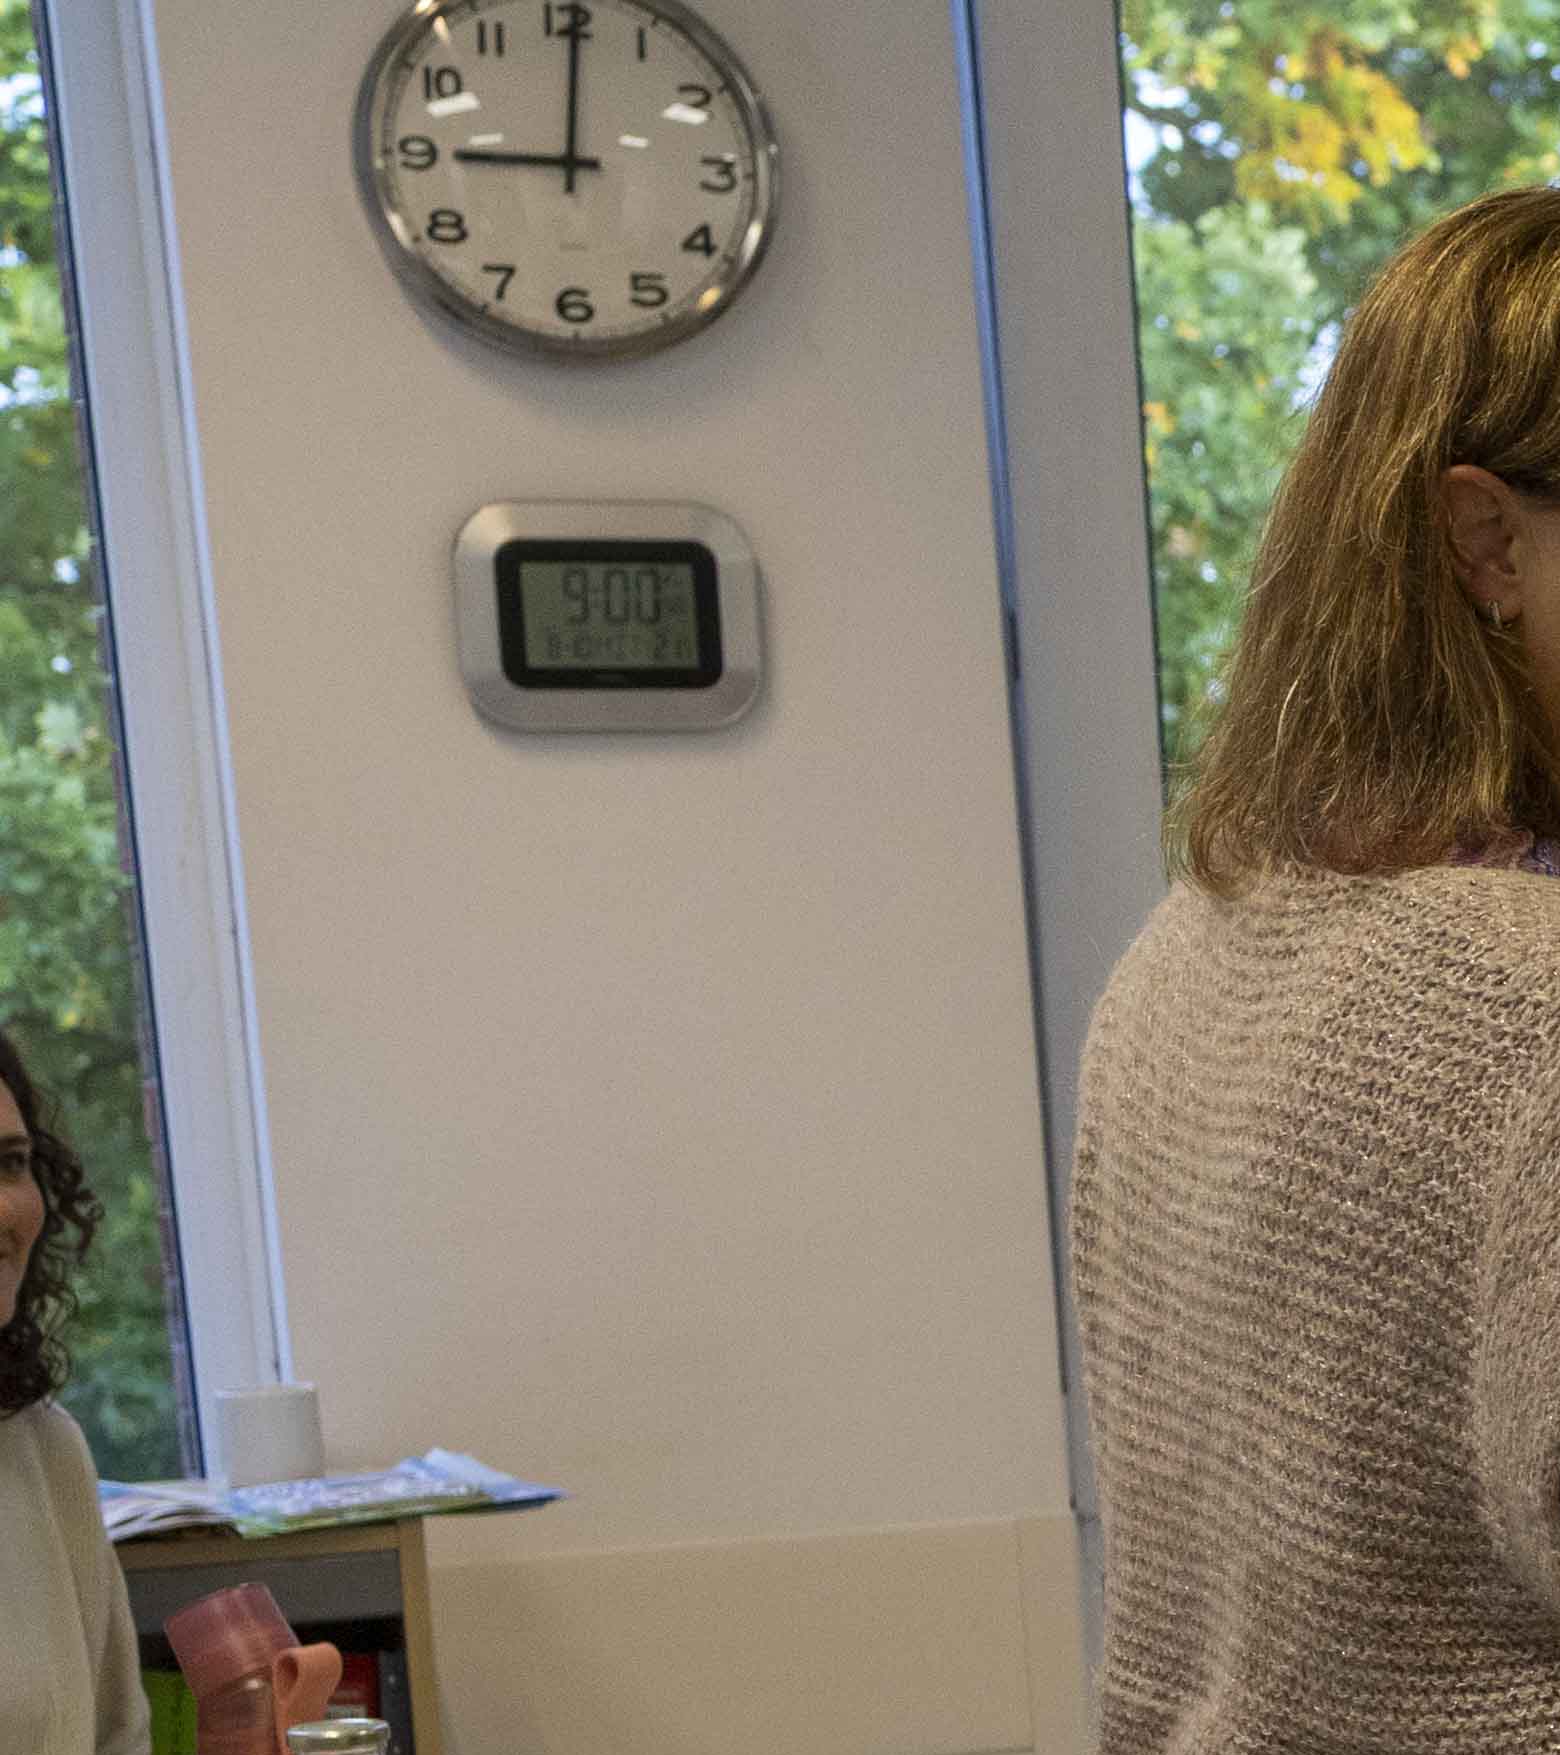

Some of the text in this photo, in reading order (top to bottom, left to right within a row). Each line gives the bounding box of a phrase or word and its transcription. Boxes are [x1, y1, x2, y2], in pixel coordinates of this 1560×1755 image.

[544, 2, 592, 38] 12
[476, 21, 504, 57] 11
[635, 26, 646, 62] 1
[423, 67, 463, 99] 10
[399, 136, 438, 170] 9
[700, 159, 736, 193] 3
[427, 209, 467, 243] 8
[682, 225, 716, 257] 4
[482, 264, 515, 300] 7
[629, 273, 668, 307] 5
[556, 288, 594, 323] 6
